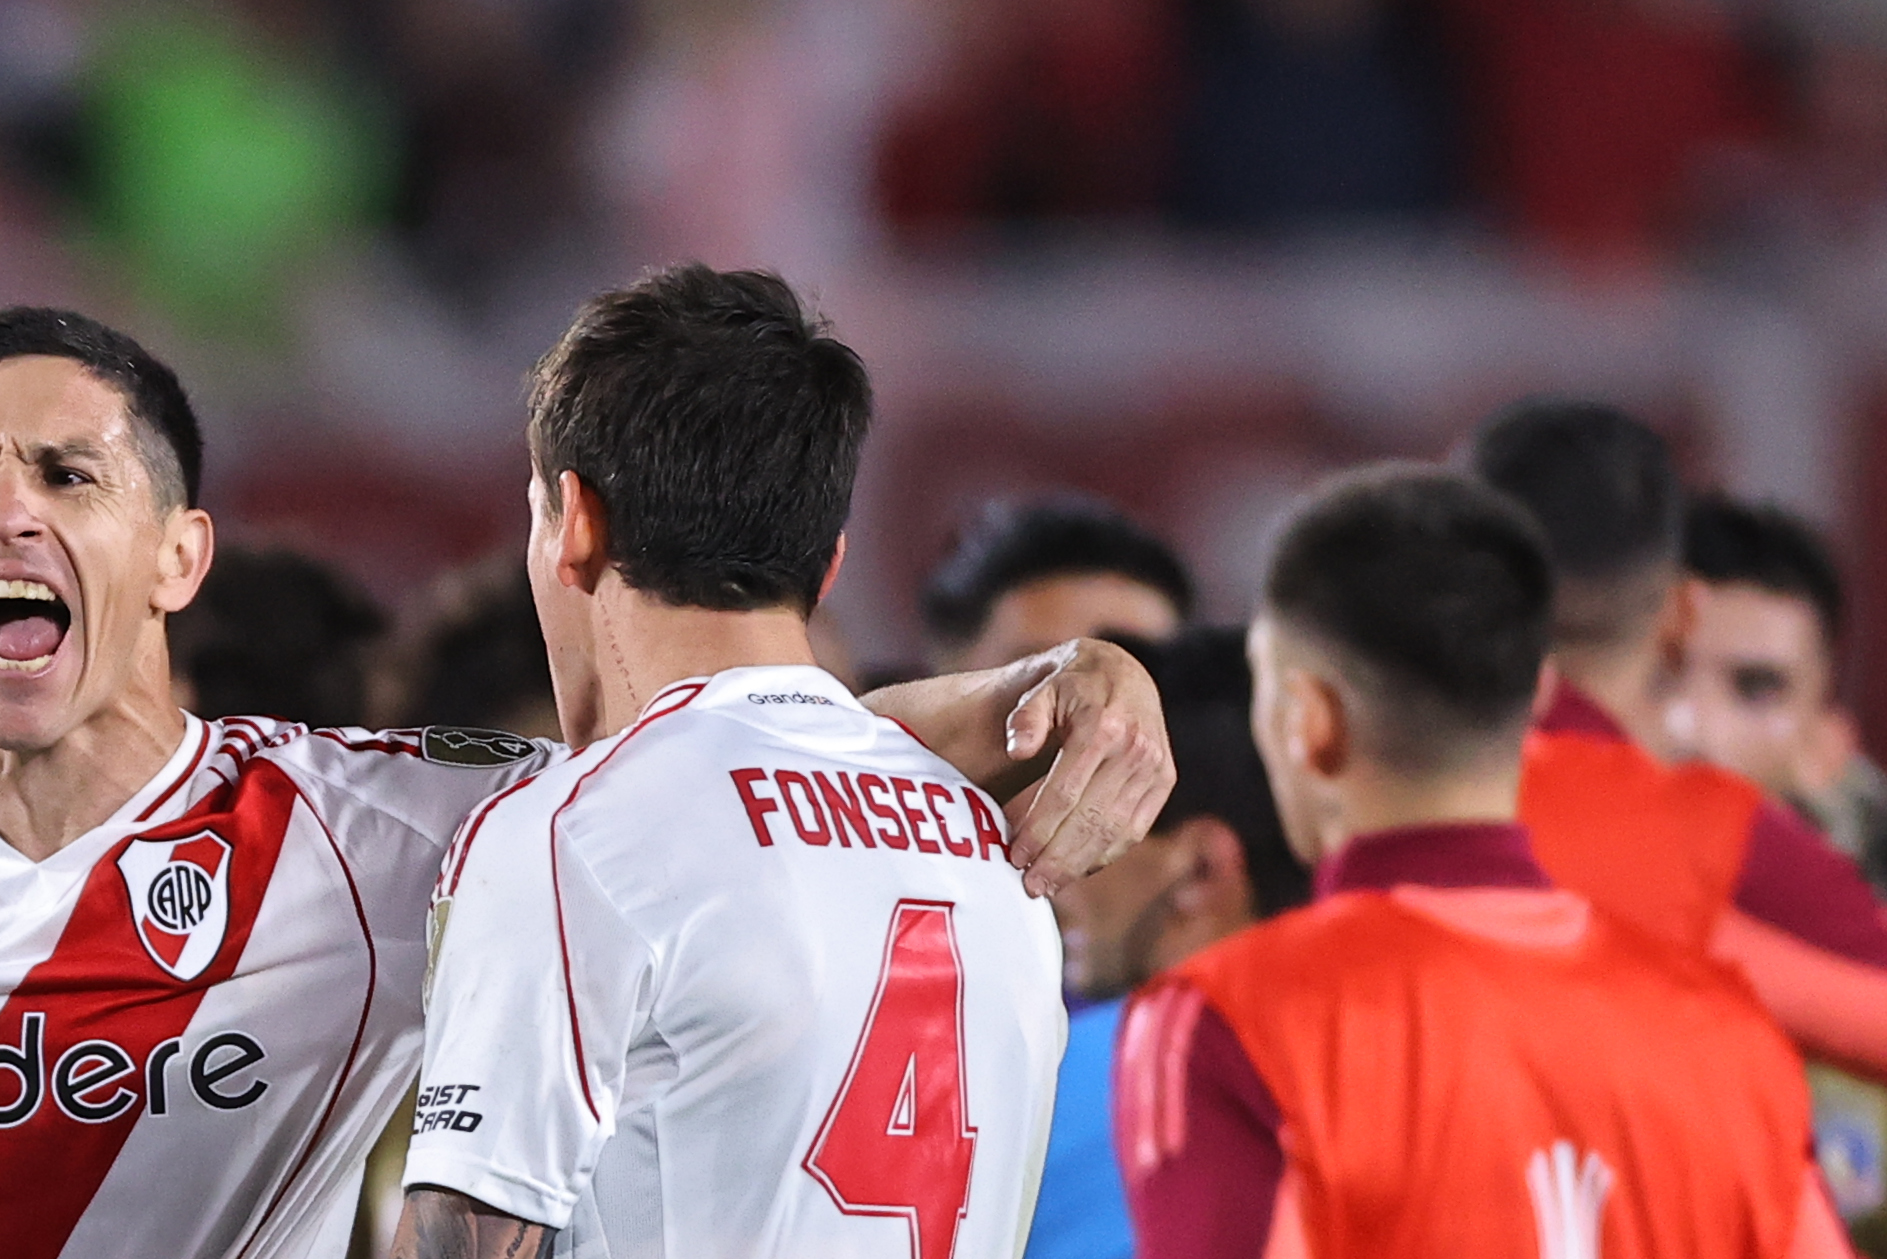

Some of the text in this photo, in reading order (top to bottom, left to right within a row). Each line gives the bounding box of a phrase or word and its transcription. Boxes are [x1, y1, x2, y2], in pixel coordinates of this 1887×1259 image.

[728, 767, 1012, 863] FONSECA
[147, 865, 212, 930] CARP
[417, 1084, 481, 1107] SIST
